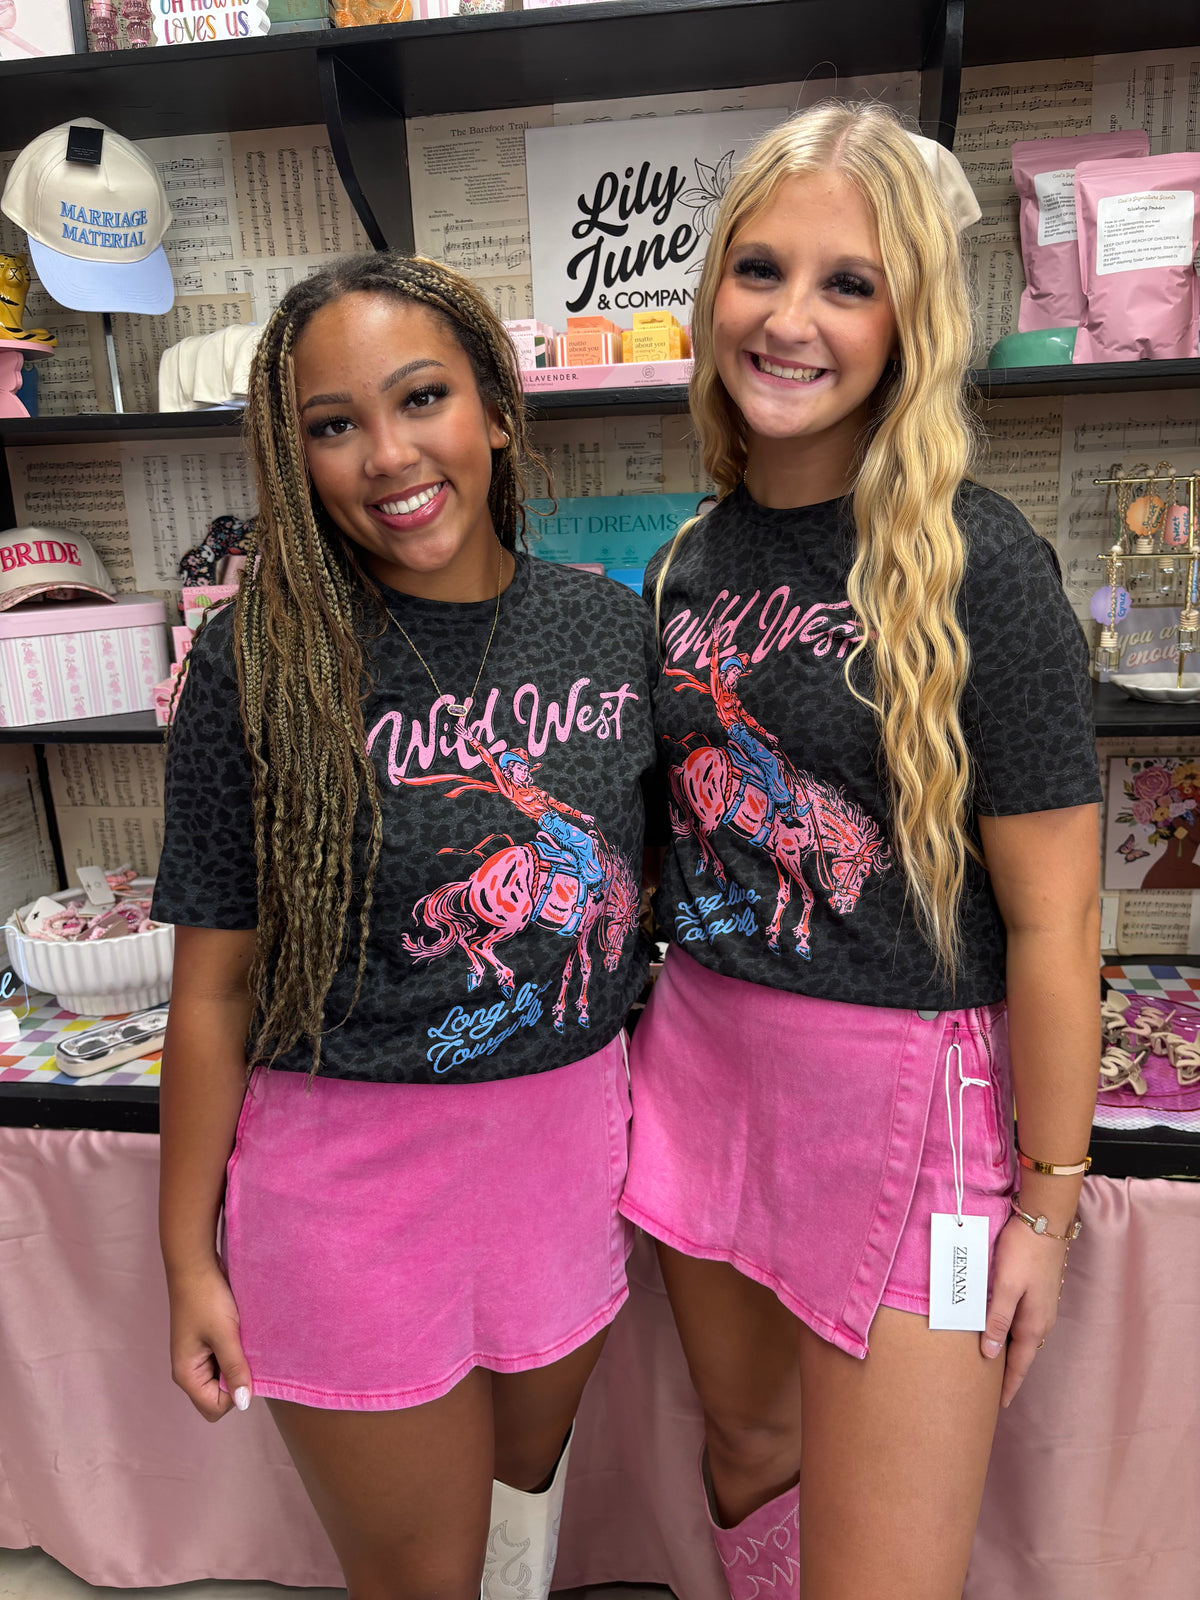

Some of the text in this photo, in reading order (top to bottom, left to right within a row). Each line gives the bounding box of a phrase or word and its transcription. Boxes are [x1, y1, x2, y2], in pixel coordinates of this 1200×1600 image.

[225, 10, 249, 37] US
[450, 129, 466, 137] The
[469, 124, 504, 134] Barefoot
[60, 200, 147, 228] MARRIAGE
[572, 161, 686, 239] Lily
[61, 222, 145, 248] MATERIAL
[566, 223, 700, 313] June
[597, 288, 698, 310] & COMPAN
[588, 513, 678, 534] DREAMS
[0, 540, 81, 573] BRIDE
[661, 589, 761, 674] Wild
[1119, 630, 1154, 658] you
[1126, 644, 1184, 669] enou
[364, 677, 639, 786] Wild West
[678, 893, 725, 921] Lng
[427, 1000, 509, 1040] Long
[955, 1246, 968, 1305] ZENANA
